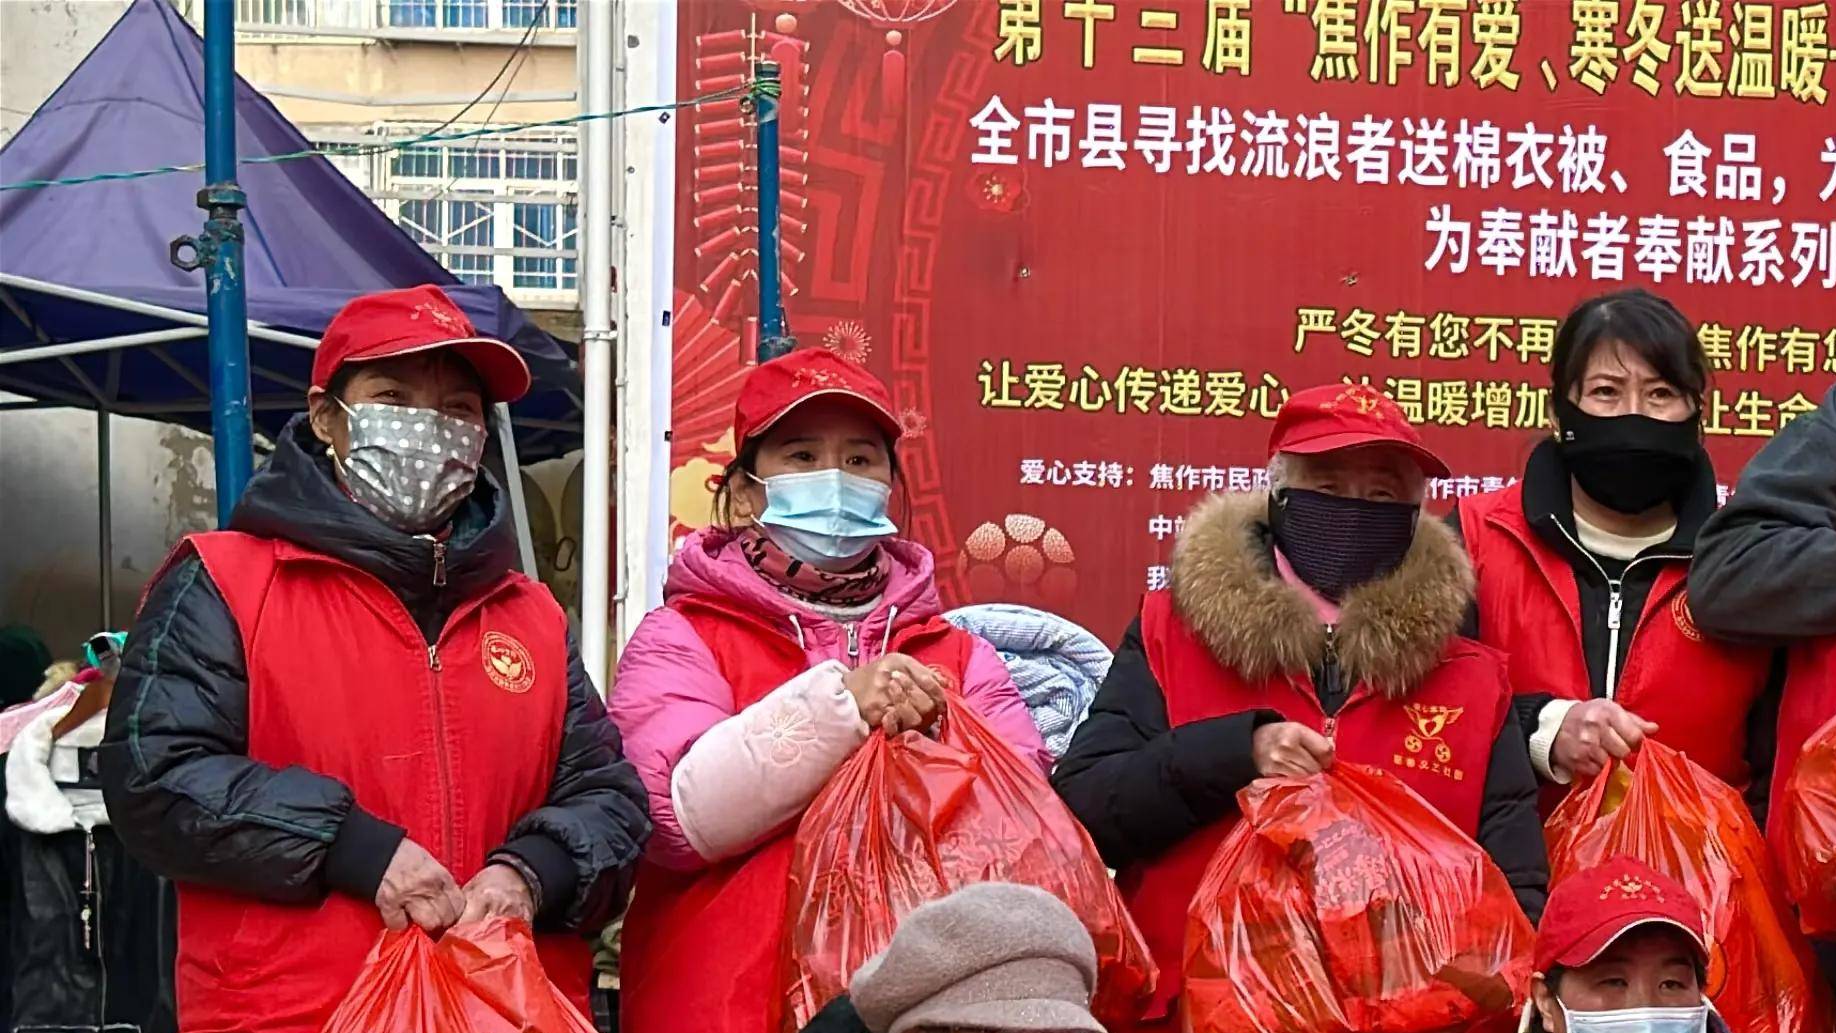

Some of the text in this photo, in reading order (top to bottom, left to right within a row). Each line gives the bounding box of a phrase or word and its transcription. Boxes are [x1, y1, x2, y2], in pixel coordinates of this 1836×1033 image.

[1294, 306, 1558, 363] 严冬有您不再
[977, 359, 1290, 418] 让爱心传递爱心
[1342, 375, 1553, 428] 温暖增加
